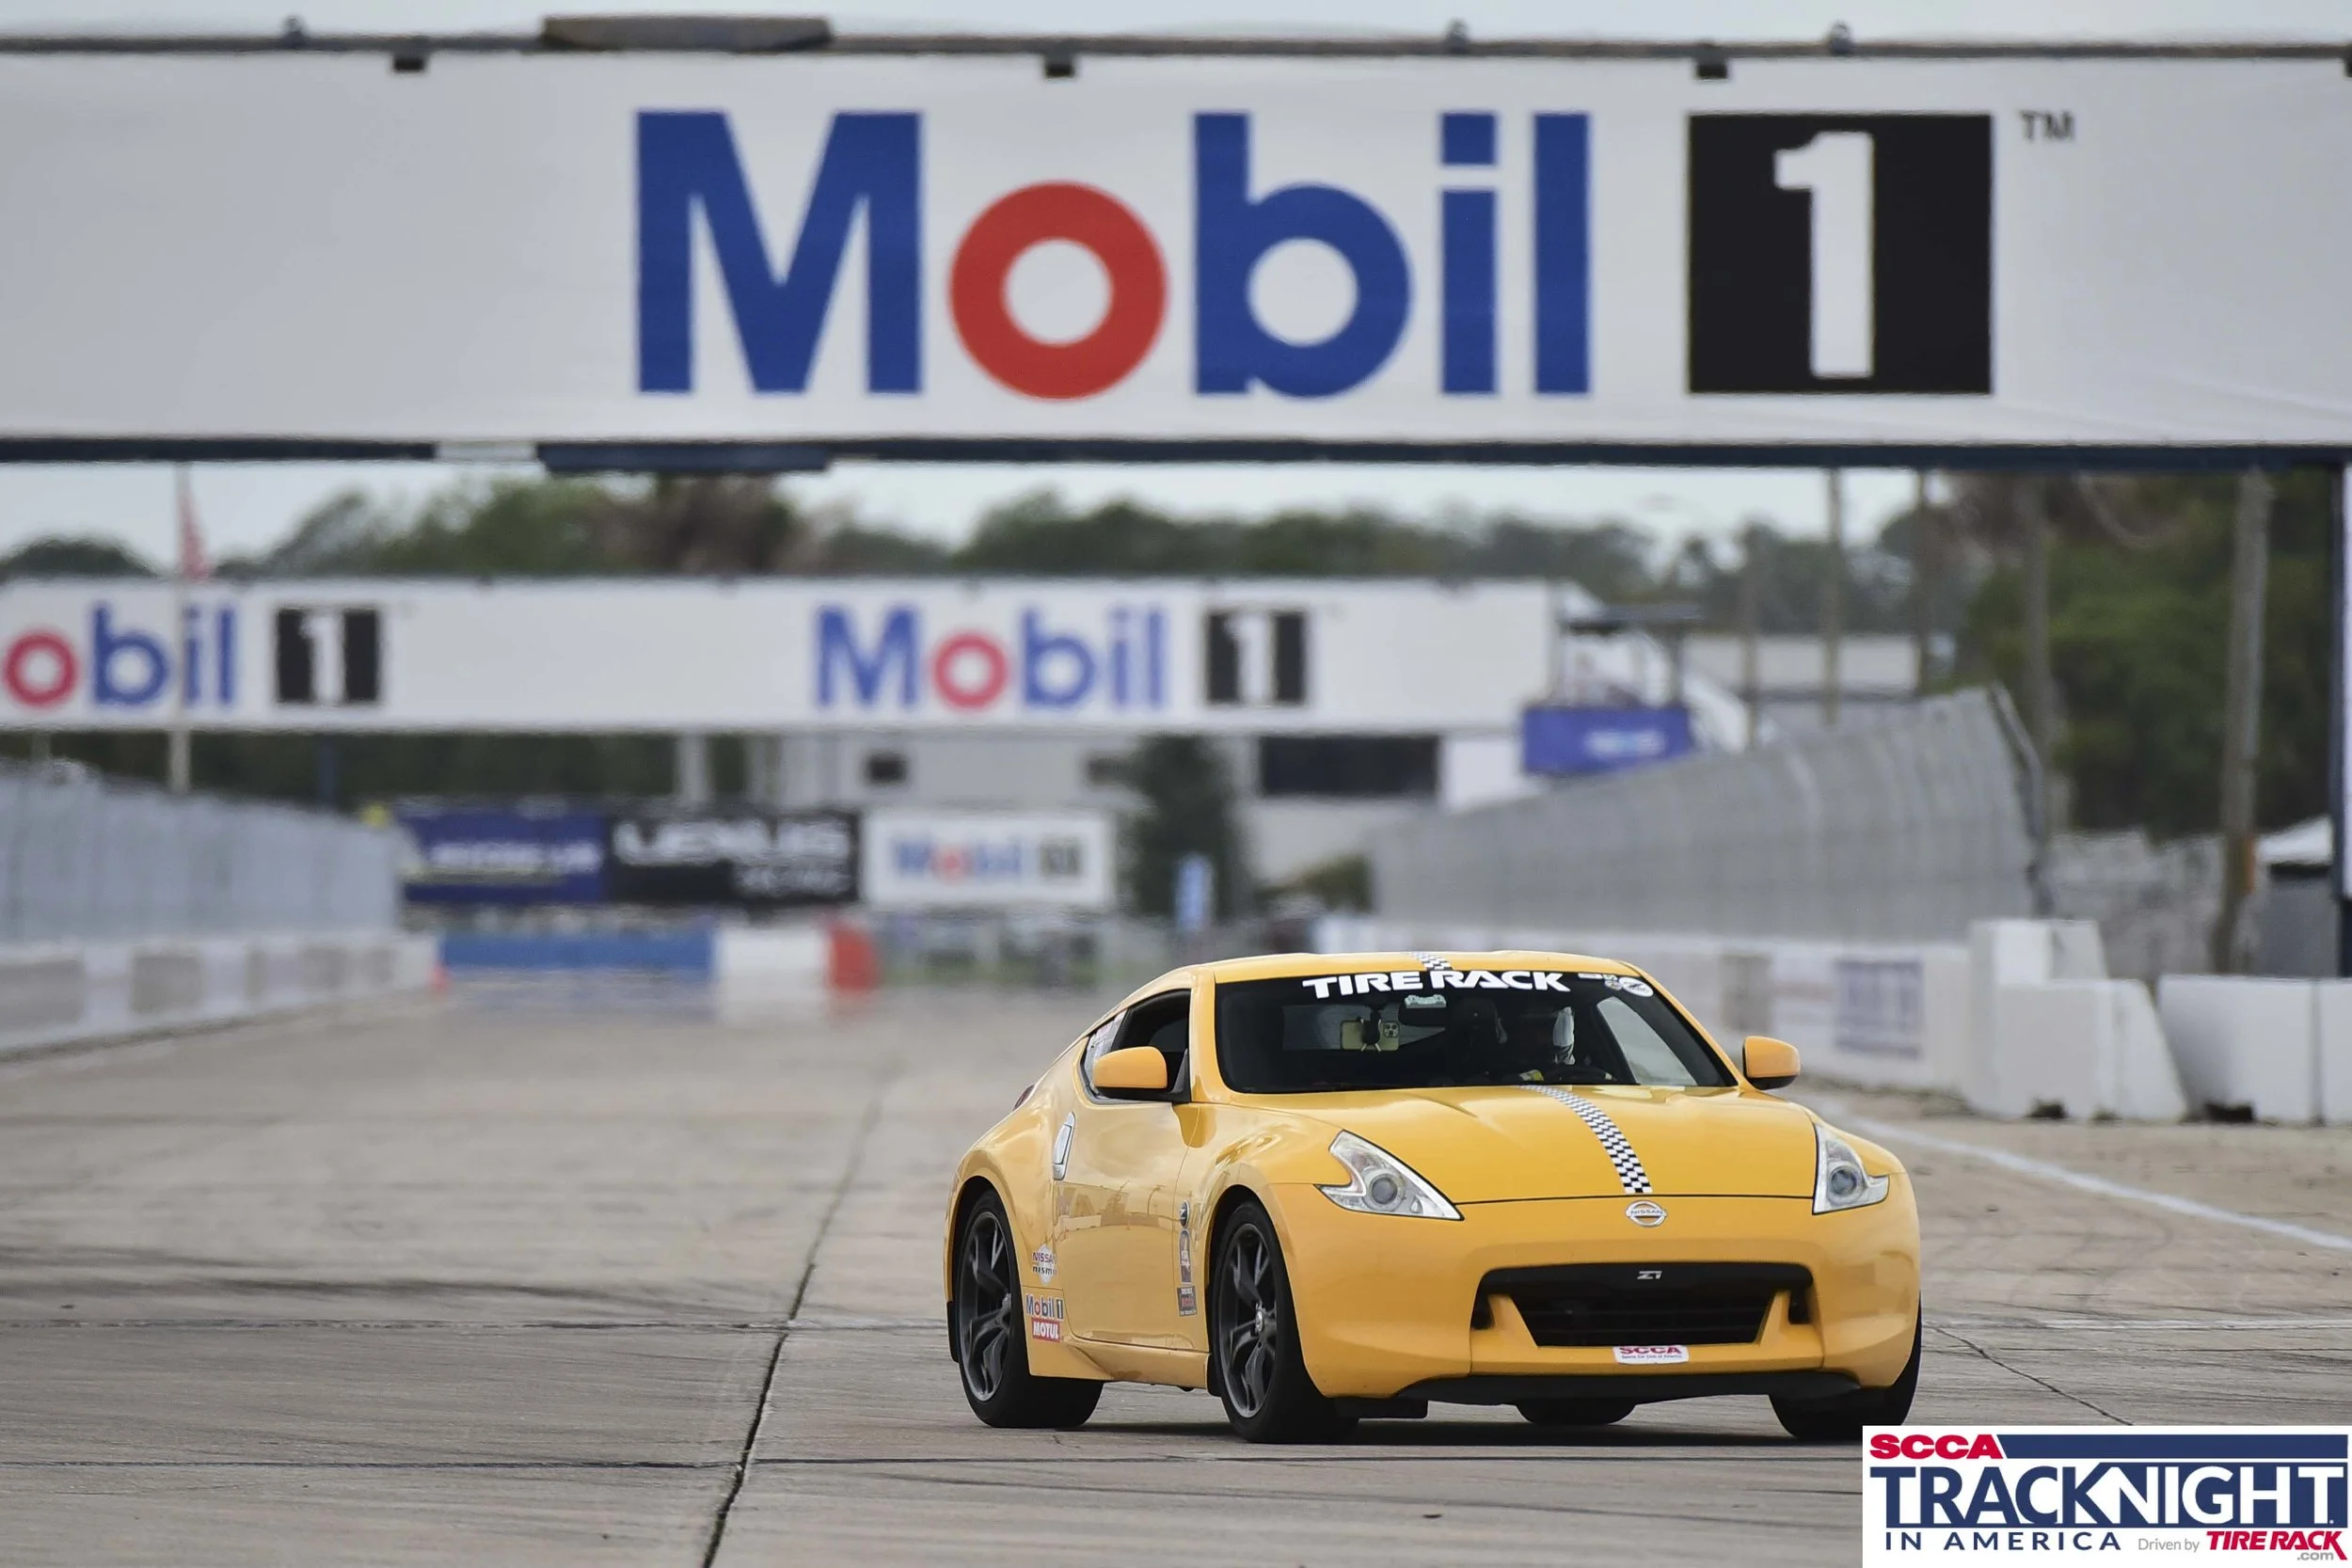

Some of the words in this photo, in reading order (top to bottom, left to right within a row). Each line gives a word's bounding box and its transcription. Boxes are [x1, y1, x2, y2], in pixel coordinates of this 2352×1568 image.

[636, 111, 1591, 400] Mobil
[1774, 131, 1874, 377] 1
[816, 605, 1165, 709] Mobil
[1302, 972, 1423, 999] TIRE
[1429, 970, 1571, 992] RACK
[1025, 1294, 1055, 1318] Mobil
[1033, 1321, 1059, 1339] MOTUL
[1619, 1346, 1682, 1354] SCCA
